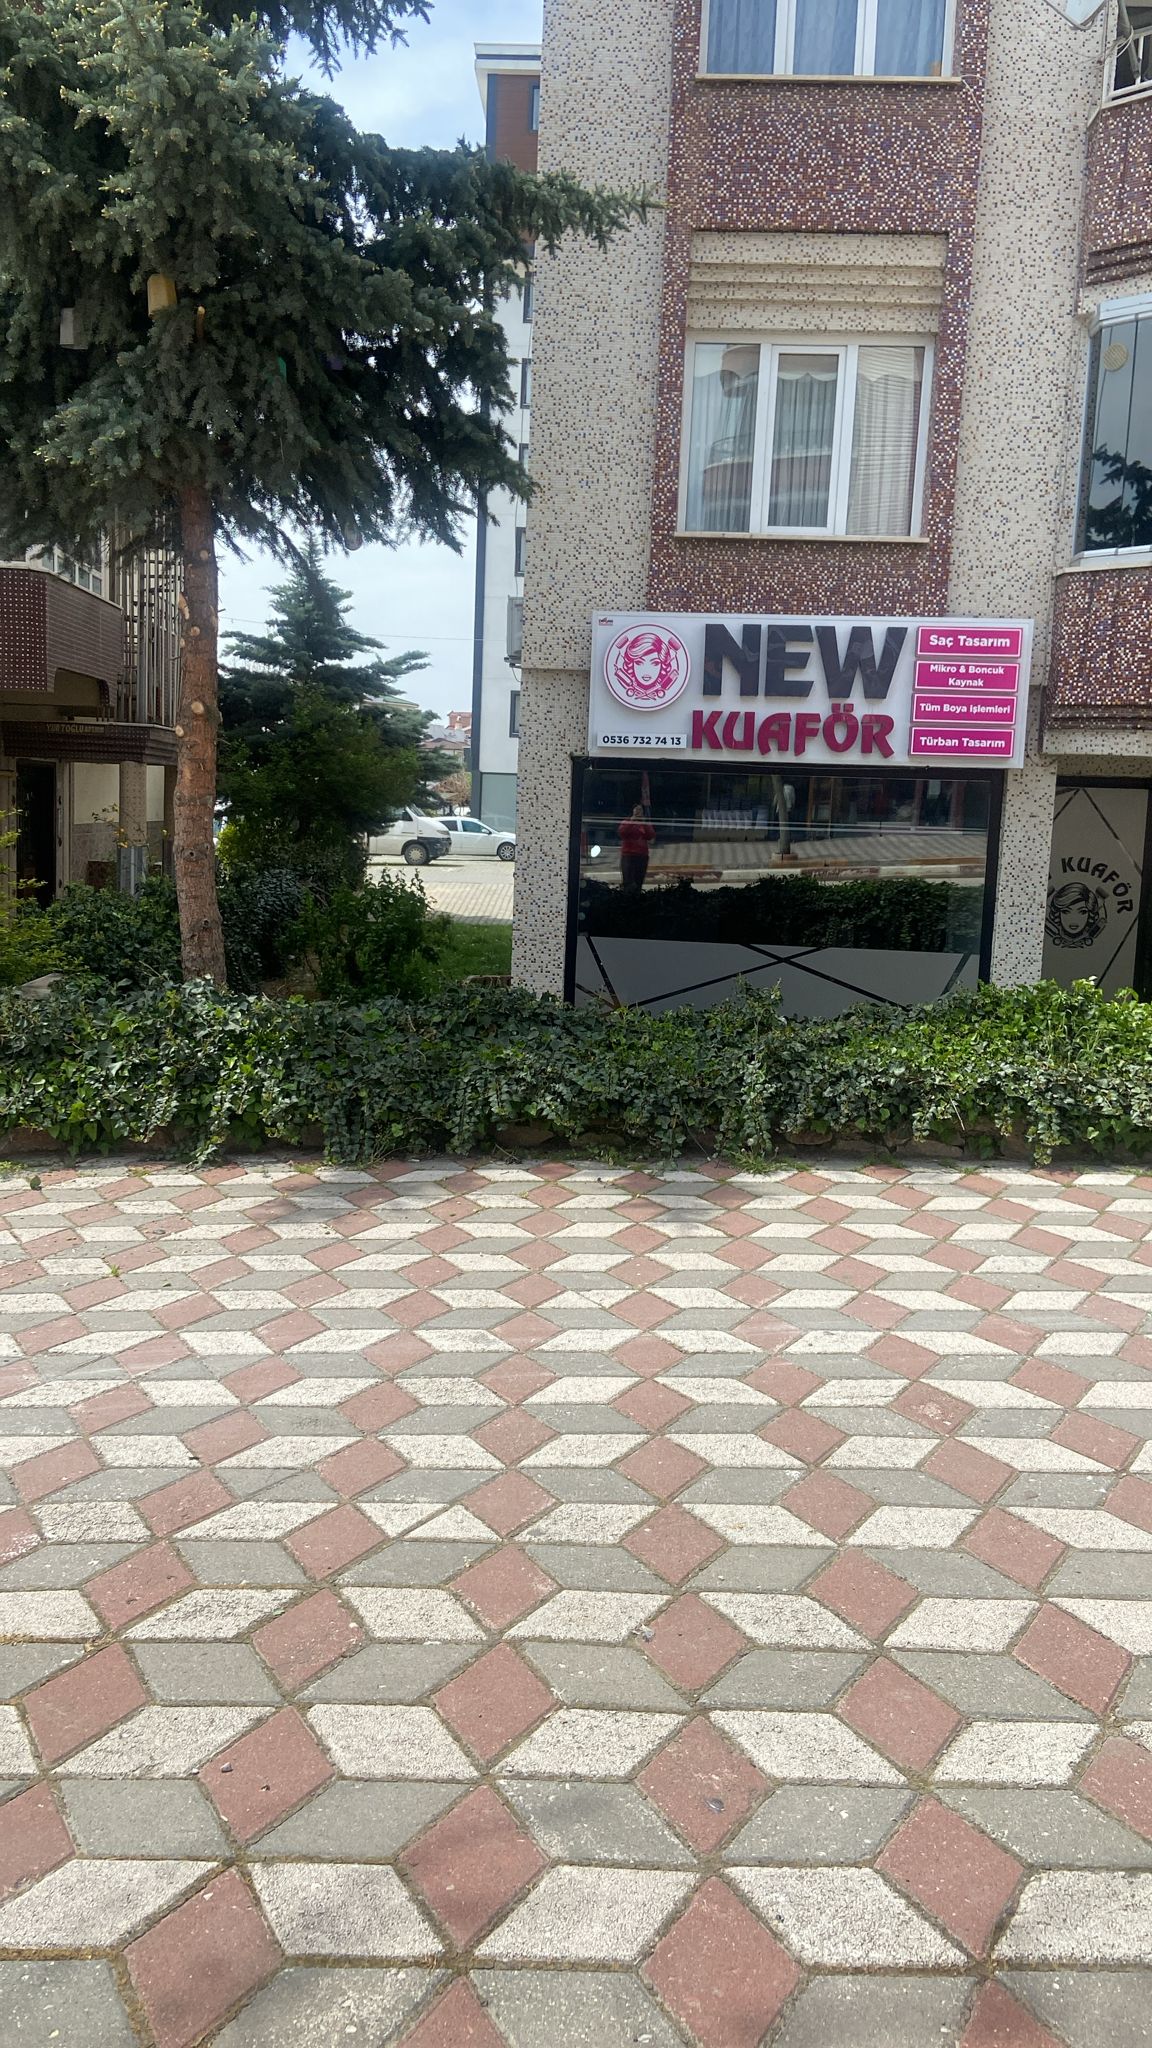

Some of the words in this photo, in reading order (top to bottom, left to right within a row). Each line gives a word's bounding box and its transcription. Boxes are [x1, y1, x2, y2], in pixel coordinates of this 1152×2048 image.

[929, 634, 954, 648] Saç
[957, 635, 1011, 648] Tasarım
[703, 624, 908, 699] NEW
[929, 664, 957, 674] Mikro
[959, 665, 966, 674] &
[968, 665, 1005, 675] Boncuk
[948, 677, 984, 688] Kaynak
[920, 703, 941, 712] Tüm
[943, 703, 967, 714] Boya
[691, 703, 895, 758] KUAFÖR
[602, 735, 630, 744] 0536
[632, 736, 652, 745] 732
[654, 736, 667, 745] 74
[670, 737, 682, 746] 13
[920, 736, 959, 747] Türban
[961, 737, 1006, 748] Tasarım
[1061, 856, 1134, 914] KUAFÖR
